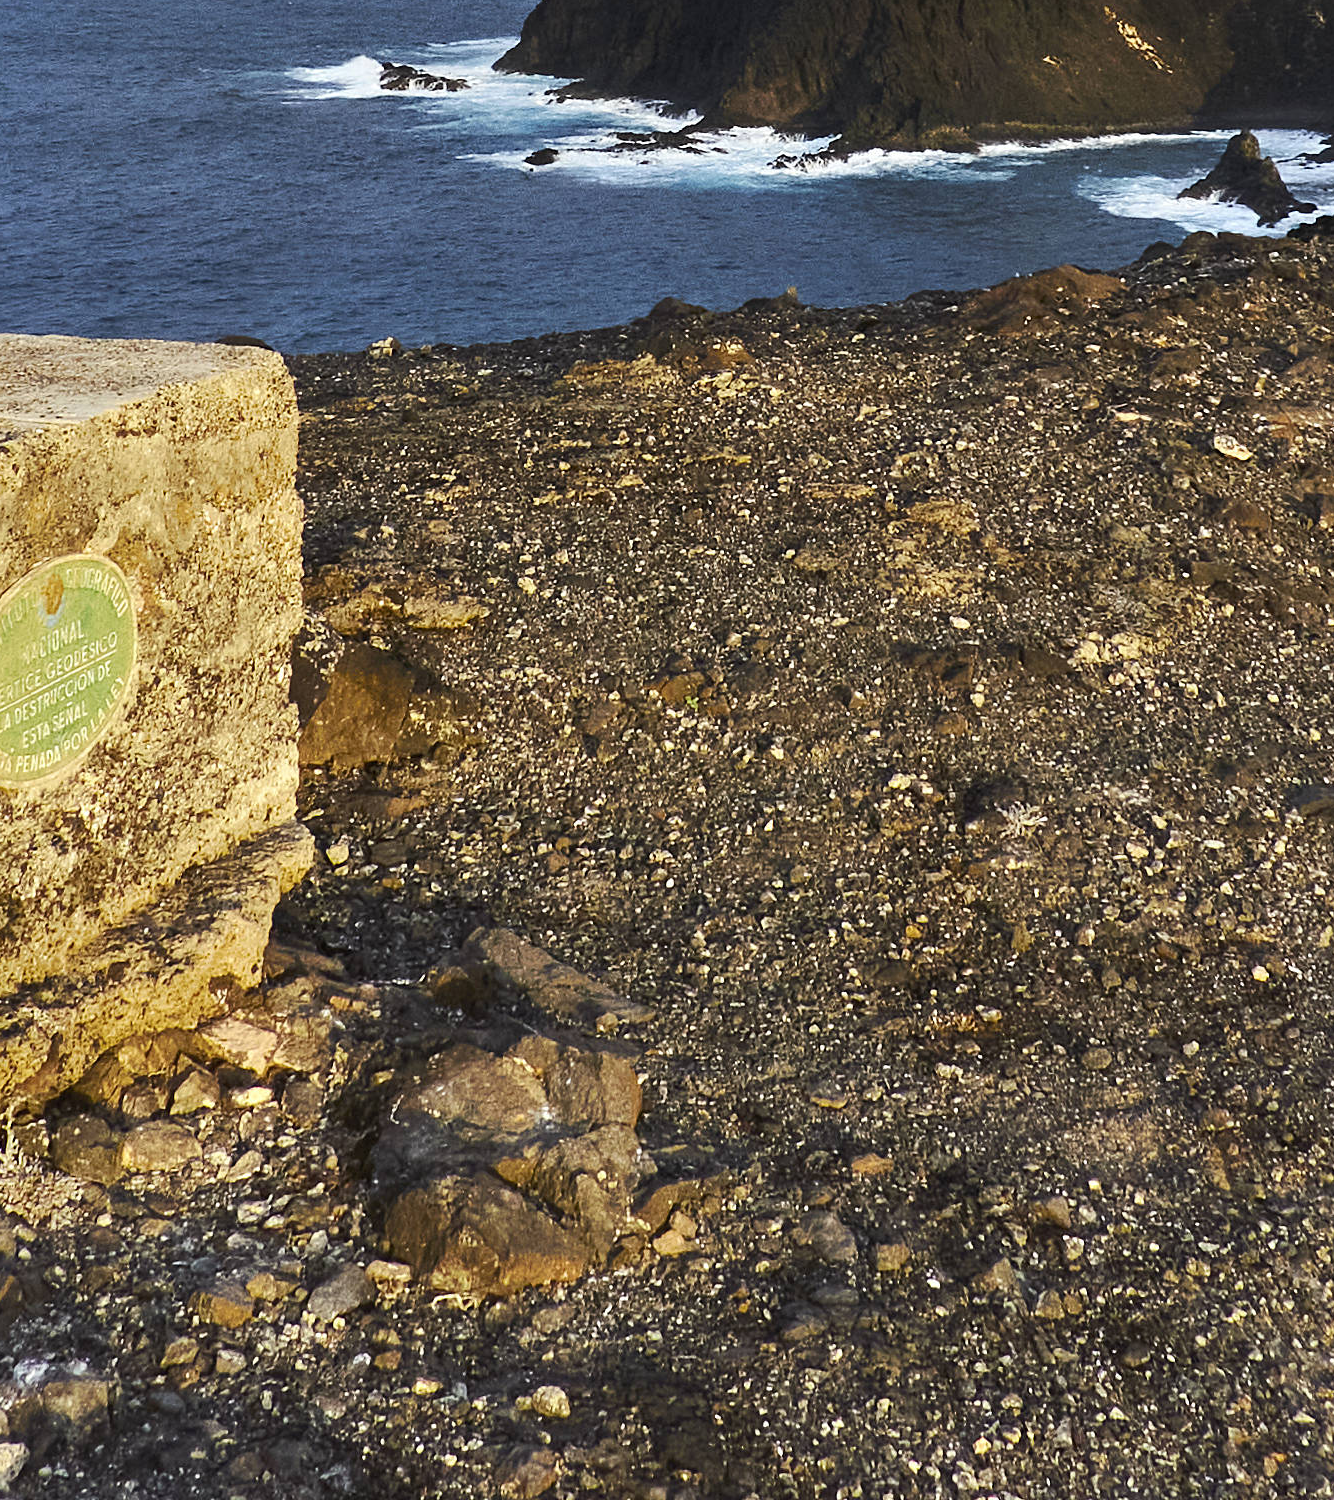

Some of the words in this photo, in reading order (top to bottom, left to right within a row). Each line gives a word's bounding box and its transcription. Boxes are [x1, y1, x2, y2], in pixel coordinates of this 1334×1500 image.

[22, 619, 85, 665] NACIONAL
[97, 659, 112, 682] DE
[15, 744, 62, 773] PENADA
[61, 725, 89, 751] POR
[90, 707, 107, 733] LA
[105, 677, 125, 710] LEY
[22, 721, 50, 749] ESTA
[52, 700, 88, 732] SEÑAL
